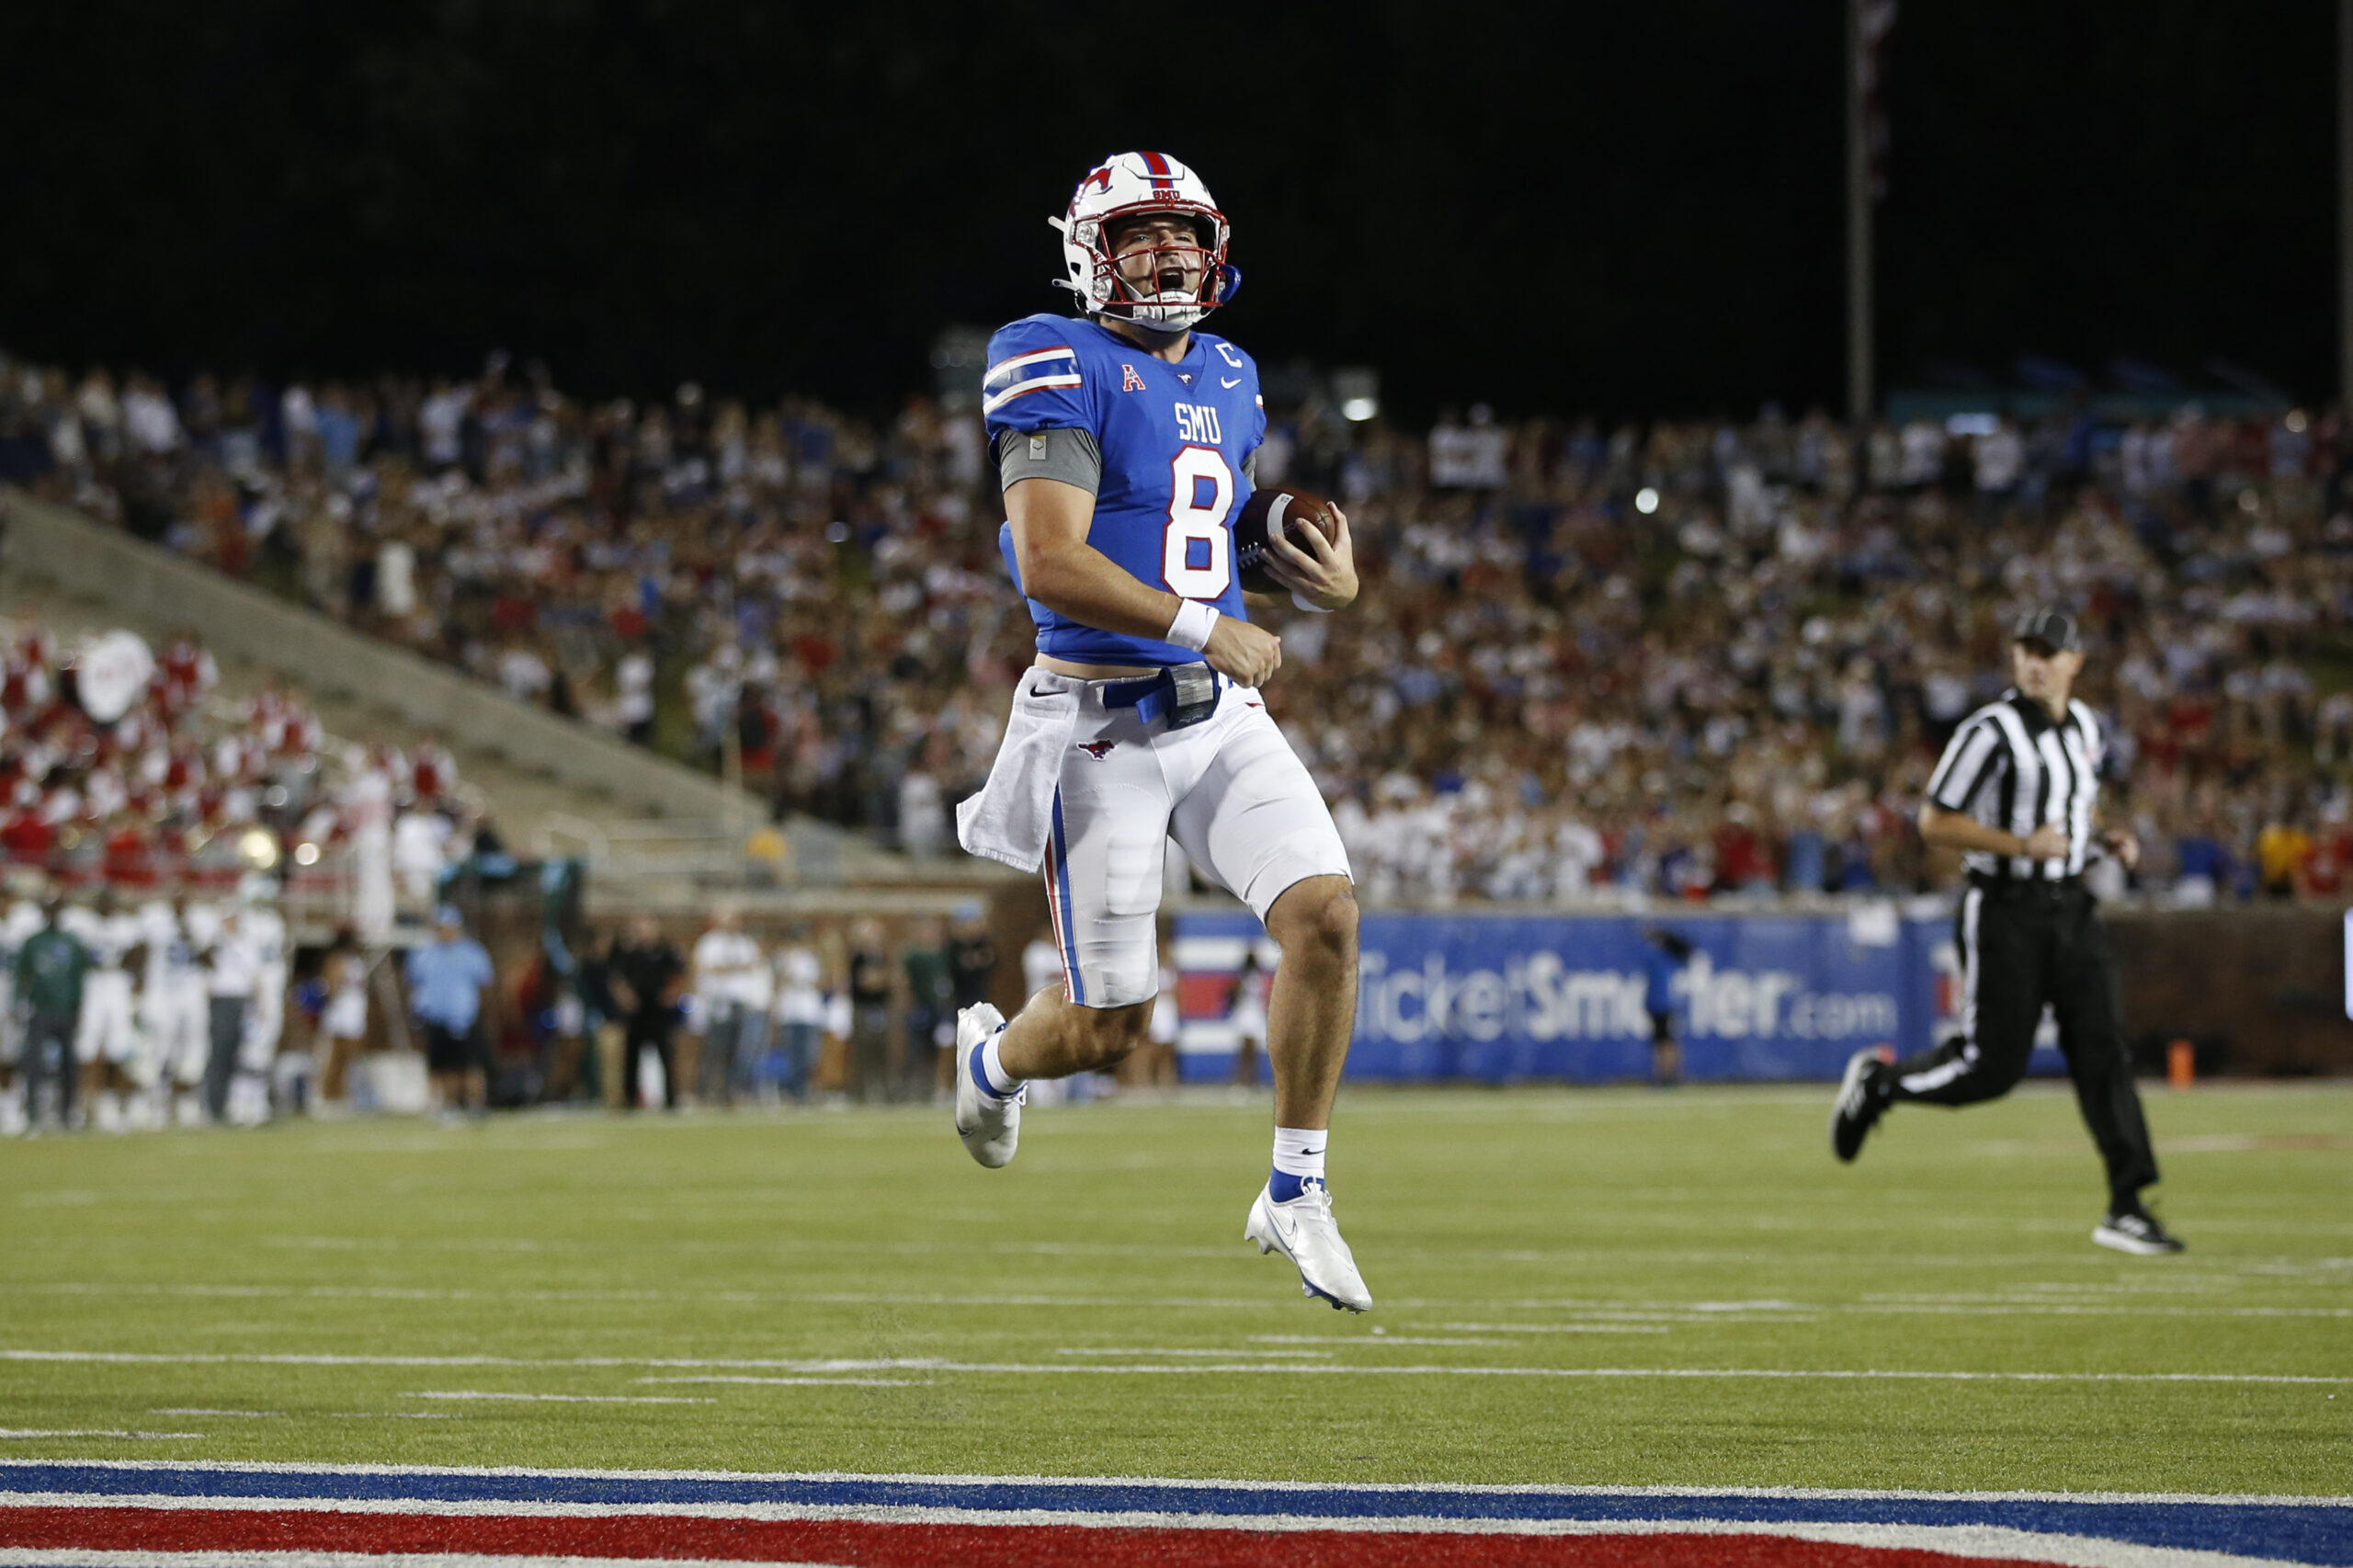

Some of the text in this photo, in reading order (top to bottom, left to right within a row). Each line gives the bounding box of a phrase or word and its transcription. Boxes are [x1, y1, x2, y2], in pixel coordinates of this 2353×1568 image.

[1153, 189, 1181, 200] SMU
[1215, 342, 1243, 369] C
[1121, 364, 1147, 392] A
[1175, 402, 1222, 445] SMU
[1161, 444, 1235, 602] 8
[1351, 949, 1899, 1044] TicketSmater.com
